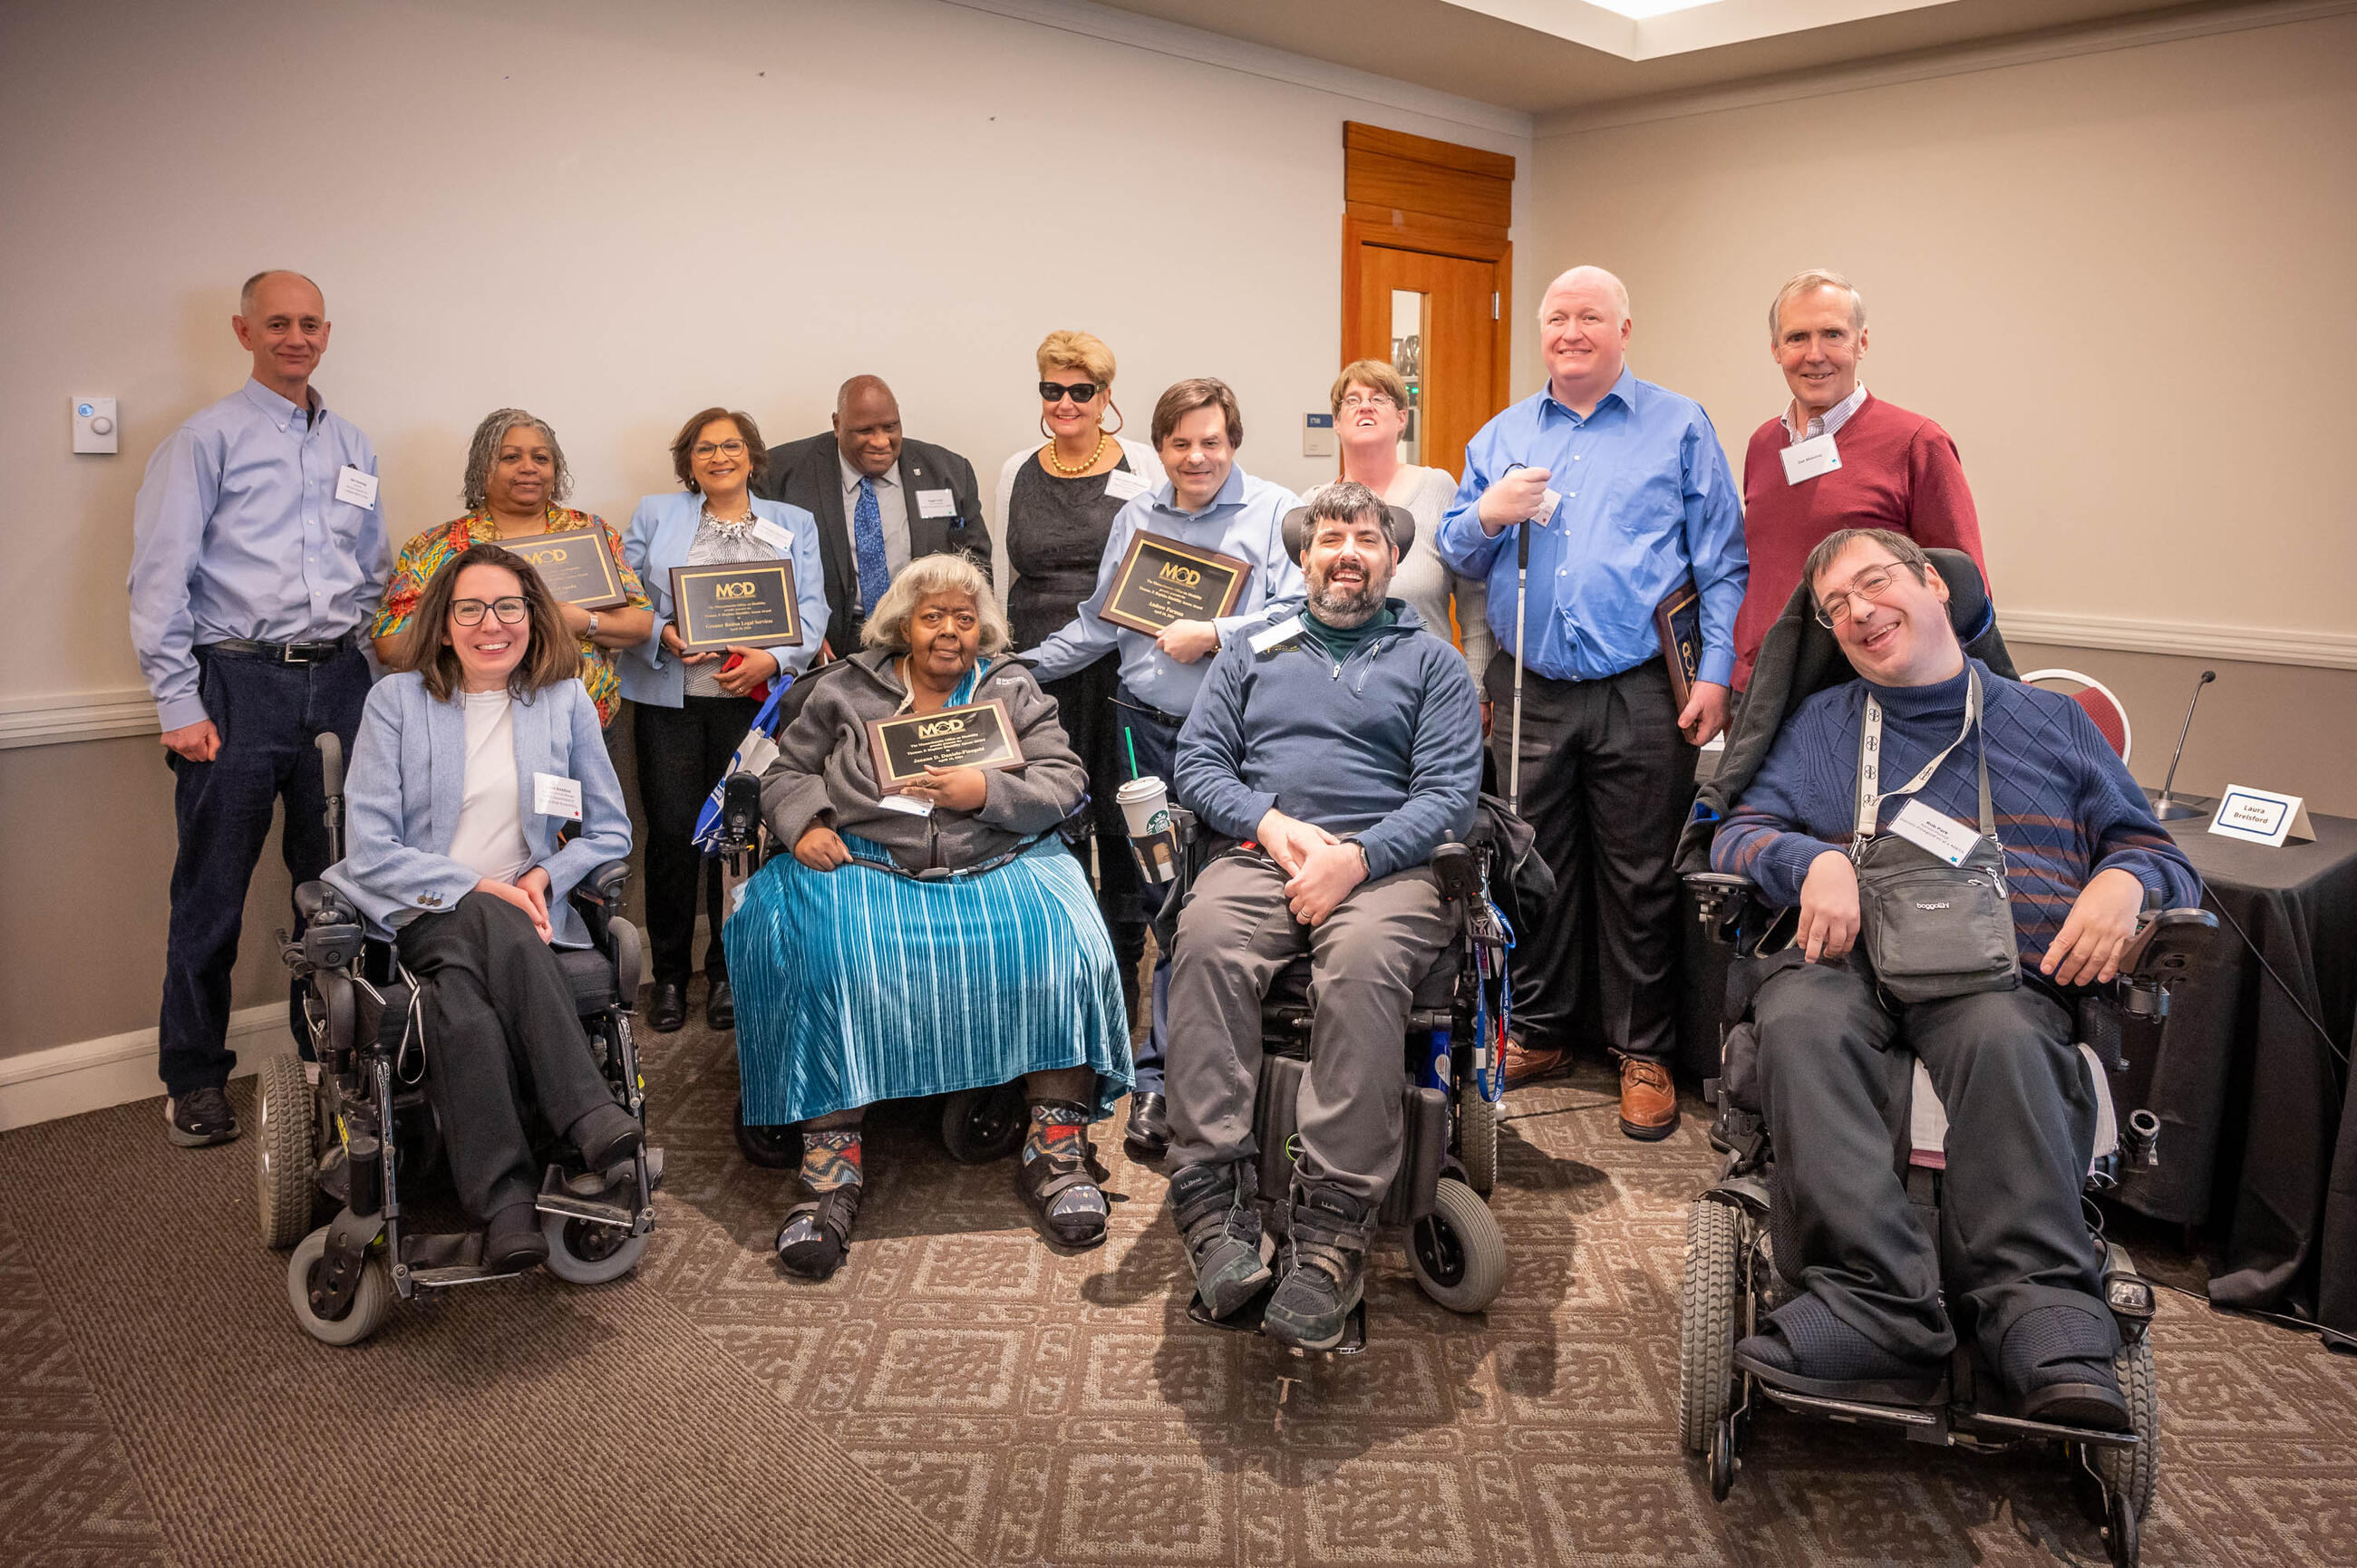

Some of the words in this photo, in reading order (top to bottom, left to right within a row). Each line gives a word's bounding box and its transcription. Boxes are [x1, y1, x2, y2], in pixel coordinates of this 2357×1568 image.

[523, 548, 567, 565] MOD
[1160, 561, 1201, 586] MOD
[715, 581, 756, 598] MOD
[917, 719, 965, 738] MOD
[2244, 805, 2265, 814] Laura
[1916, 902, 1949, 910] baggallini
